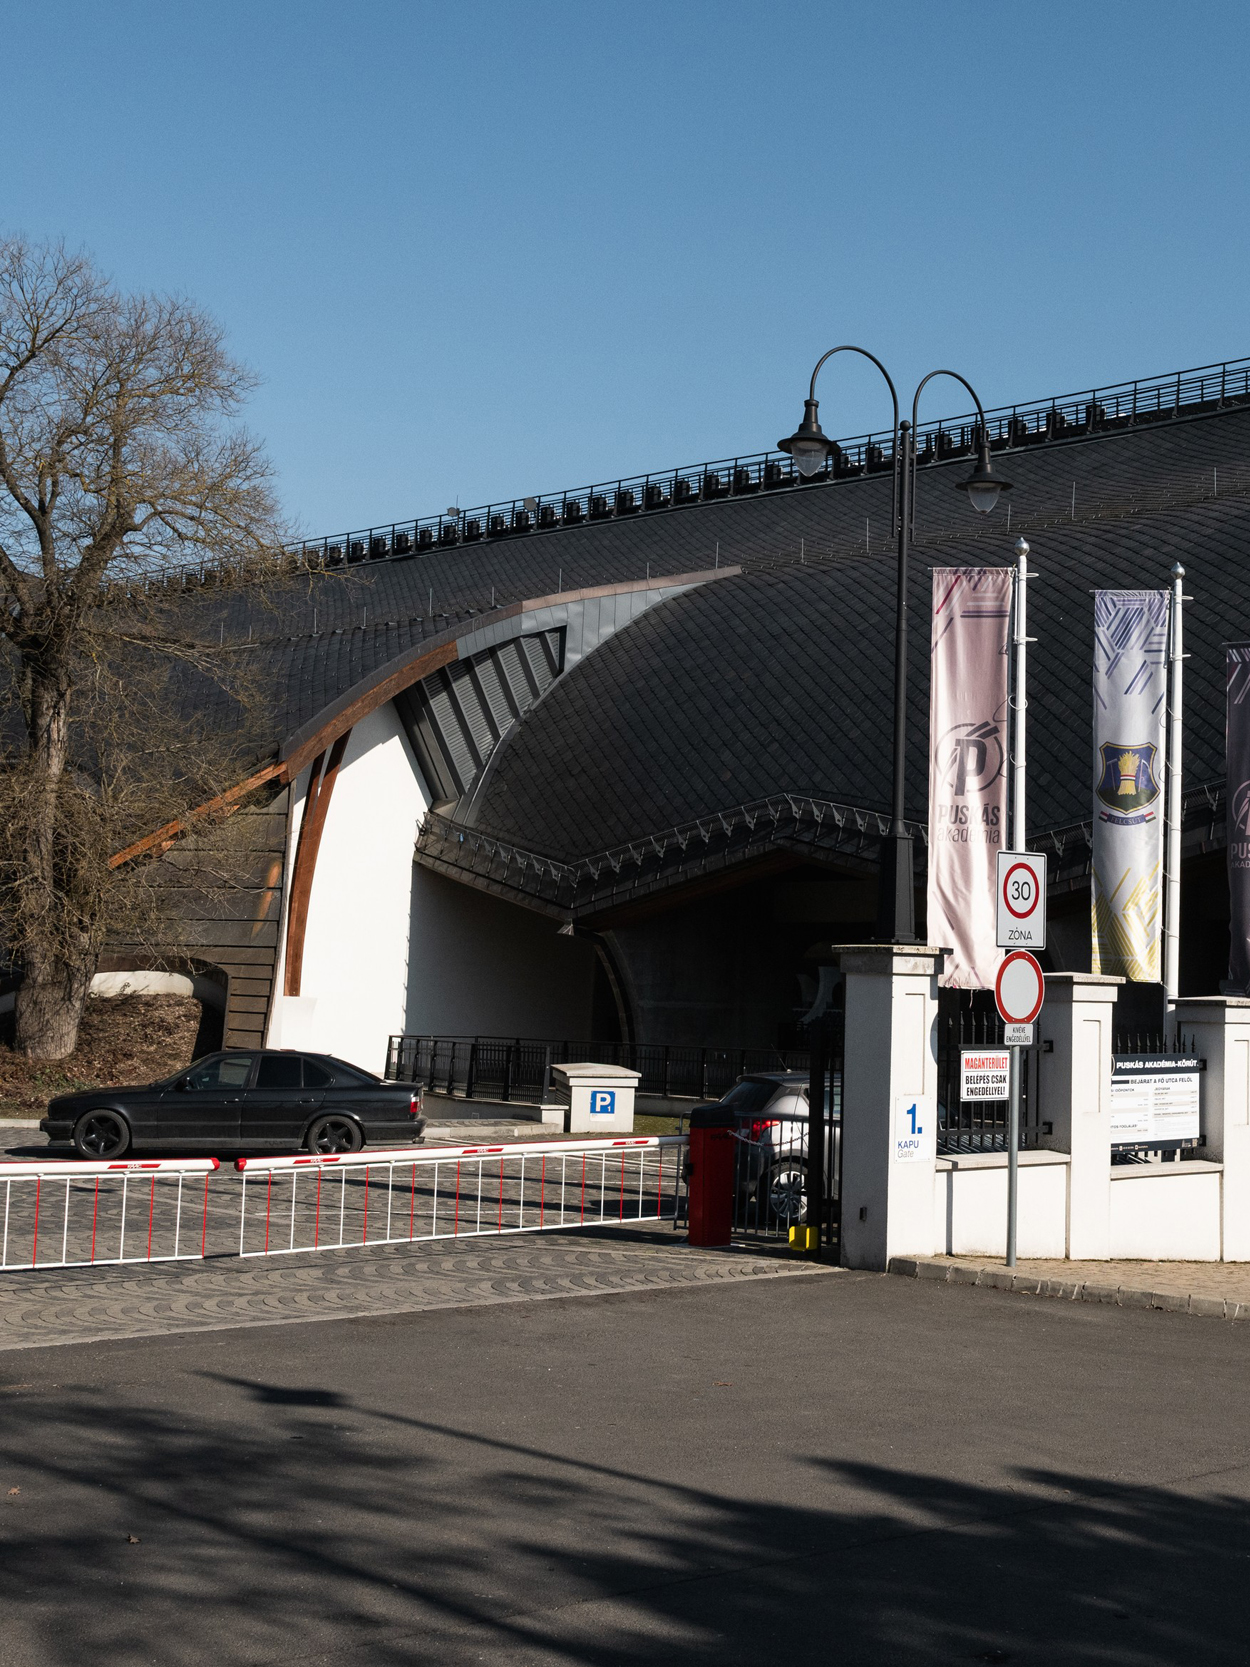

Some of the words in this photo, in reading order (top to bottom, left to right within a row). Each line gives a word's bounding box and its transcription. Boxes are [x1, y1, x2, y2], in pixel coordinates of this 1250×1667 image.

[937, 803, 1001, 827] PUSKÁS
[936, 826, 1000, 844] akadémia
[1011, 881, 1032, 901] 30
[1008, 926, 1033, 941] ZÓNA
[964, 1055, 1008, 1070] MAGÁNTERÜLET
[1116, 1060, 1144, 1069] PUSKÁS
[965, 1073, 990, 1085] BELÉPÉS
[990, 1074, 1007, 1084] CSAK
[966, 1085, 1006, 1096] ENGEDÉLLYEL!
[595, 1093, 612, 1112] P
[906, 1103, 923, 1135] 1.
[897, 1139, 920, 1149] KAPU
[897, 1148, 915, 1159] Gate
